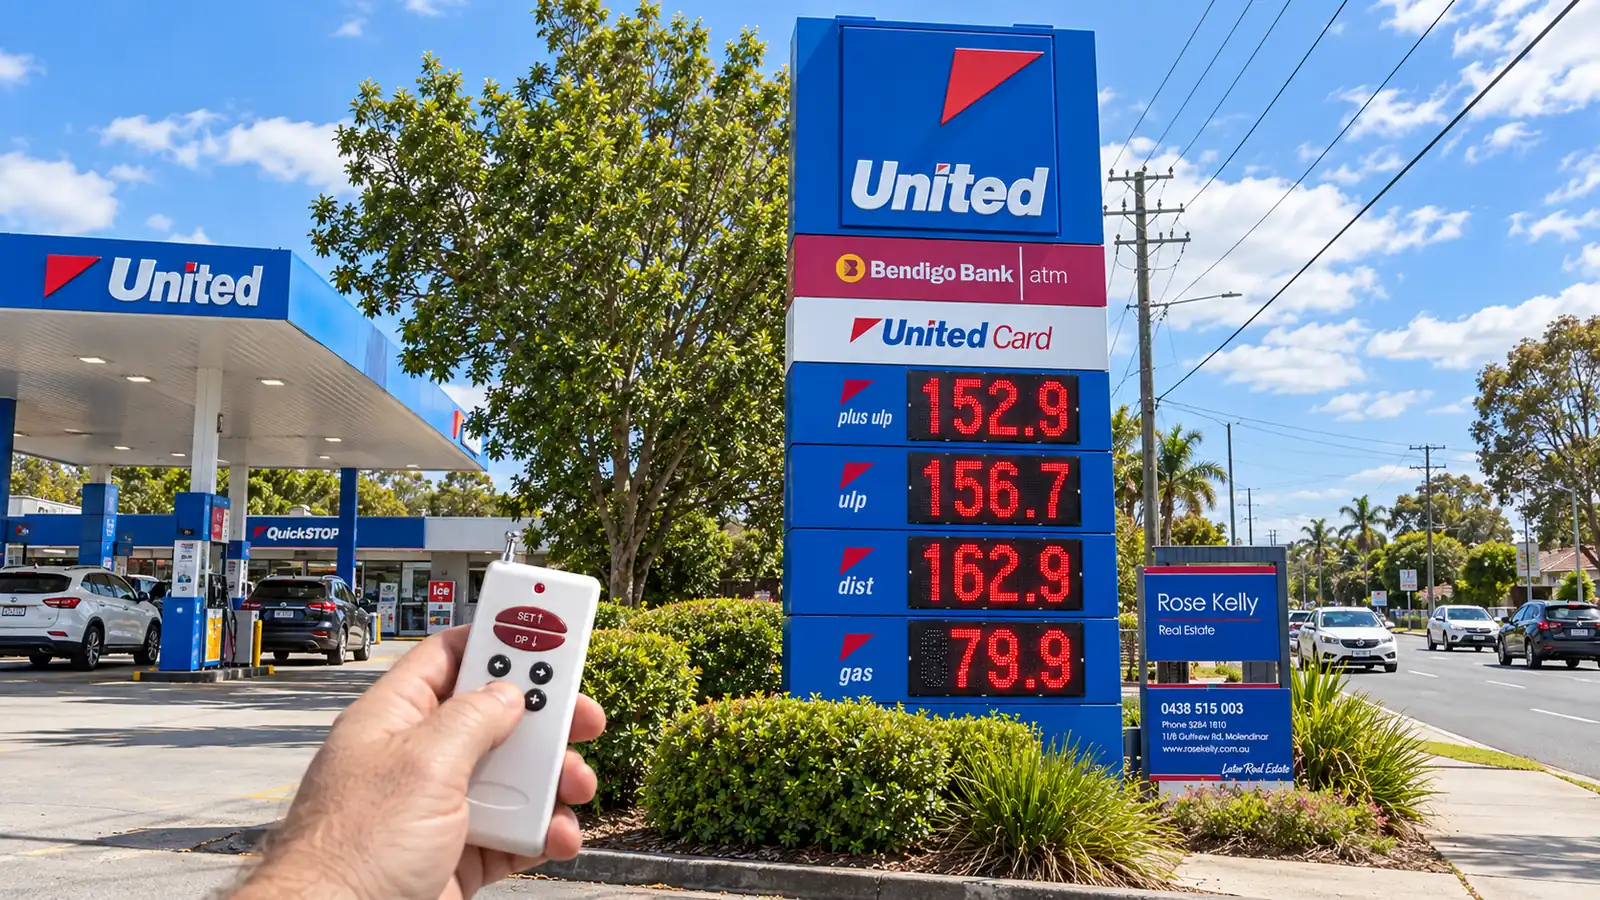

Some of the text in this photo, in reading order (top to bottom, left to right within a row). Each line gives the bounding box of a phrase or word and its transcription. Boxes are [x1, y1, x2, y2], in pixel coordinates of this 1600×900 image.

[850, 159, 1050, 217] United
[108, 257, 264, 307] United
[870, 260, 957, 285] Bendigo
[960, 263, 1014, 283] Bank
[1029, 267, 1068, 284] atm
[882, 318, 1053, 350] United Card
[922, 377, 1069, 437] 152.9
[838, 408, 893, 429] plus ulp
[923, 459, 1069, 519] 156.7
[838, 490, 867, 513] ulp
[266, 526, 339, 541] QuickSTOP
[923, 543, 1070, 603] 162.9
[433, 585, 450, 596] Ice
[838, 575, 875, 596] dist
[1157, 592, 1259, 616] Rose Kelly
[517, 611, 536, 623] SET
[514, 634, 529, 645] DP
[1158, 625, 1216, 636] Real Estate
[951, 628, 1071, 689] 79.9
[839, 664, 874, 686] gas
[1161, 702, 1244, 715] 0438 515 003
[1162, 720, 1187, 729] Phone
